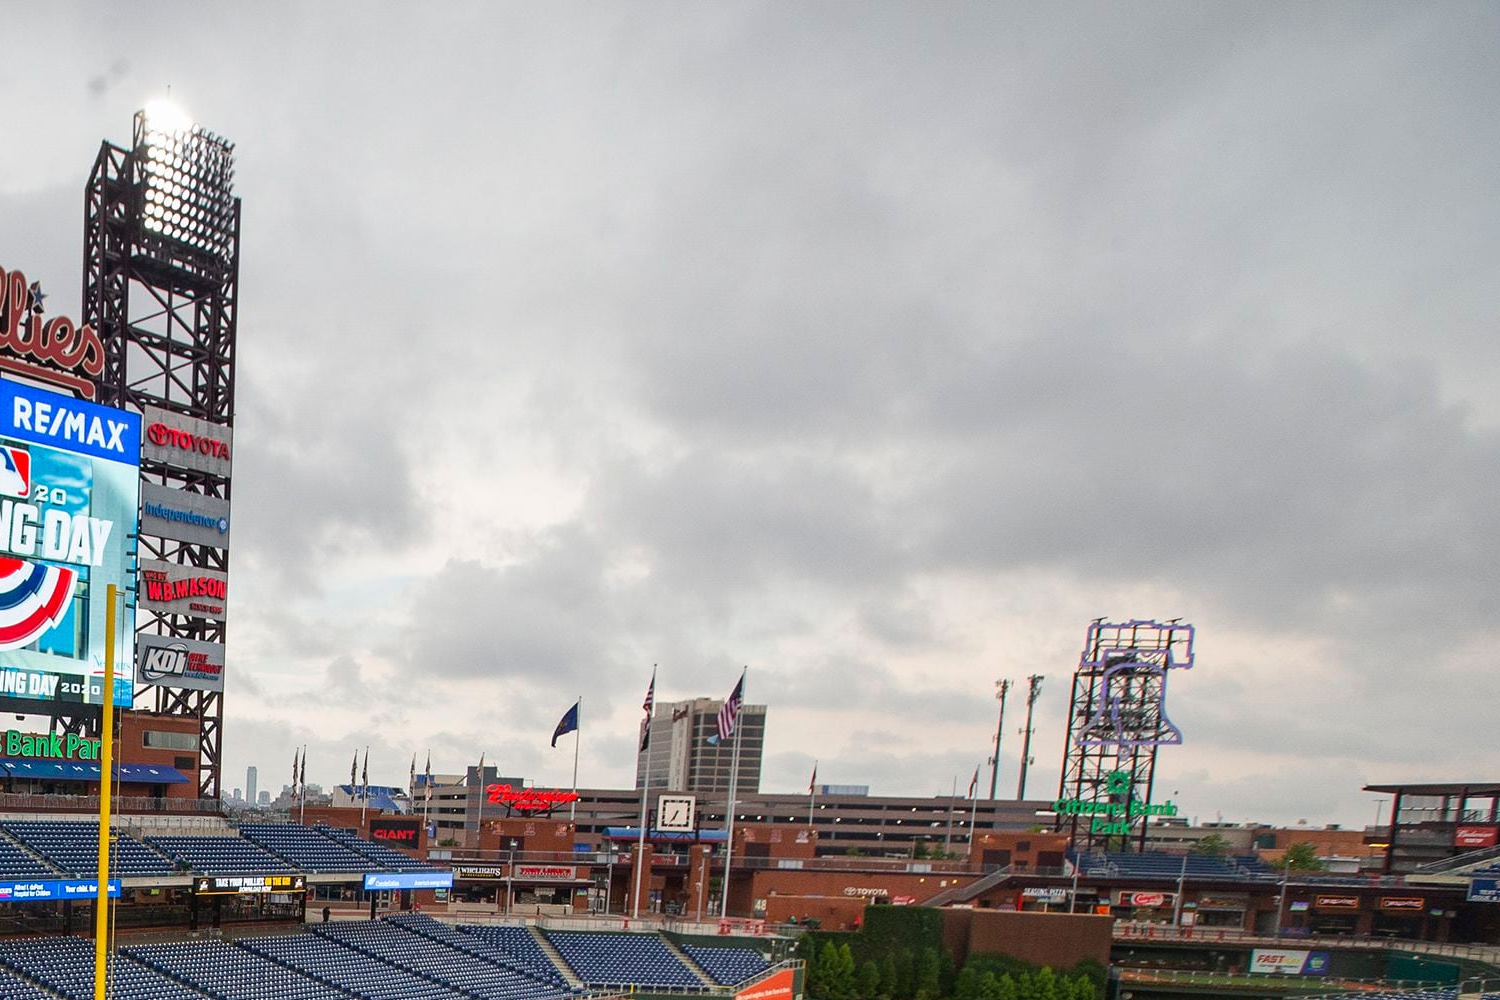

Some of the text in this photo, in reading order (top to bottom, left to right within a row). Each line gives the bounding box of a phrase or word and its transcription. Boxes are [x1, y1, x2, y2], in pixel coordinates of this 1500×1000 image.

[13, 396, 128, 453] RE/MAX
[170, 428, 230, 461] TOYOTA
[42, 510, 114, 567] DAY
[144, 647, 188, 675] KDI
[29, 673, 60, 698] DAY
[60, 681, 100, 696] 2020
[7, 730, 63, 759] Bank
[66, 733, 113, 761] Par
[1053, 799, 1178, 816] Citizens Bank
[373, 829, 415, 840] GIANT
[1091, 818, 1131, 835] Park
[857, 888, 888, 897] TOYOTA
[1257, 954, 1285, 964] FAST
